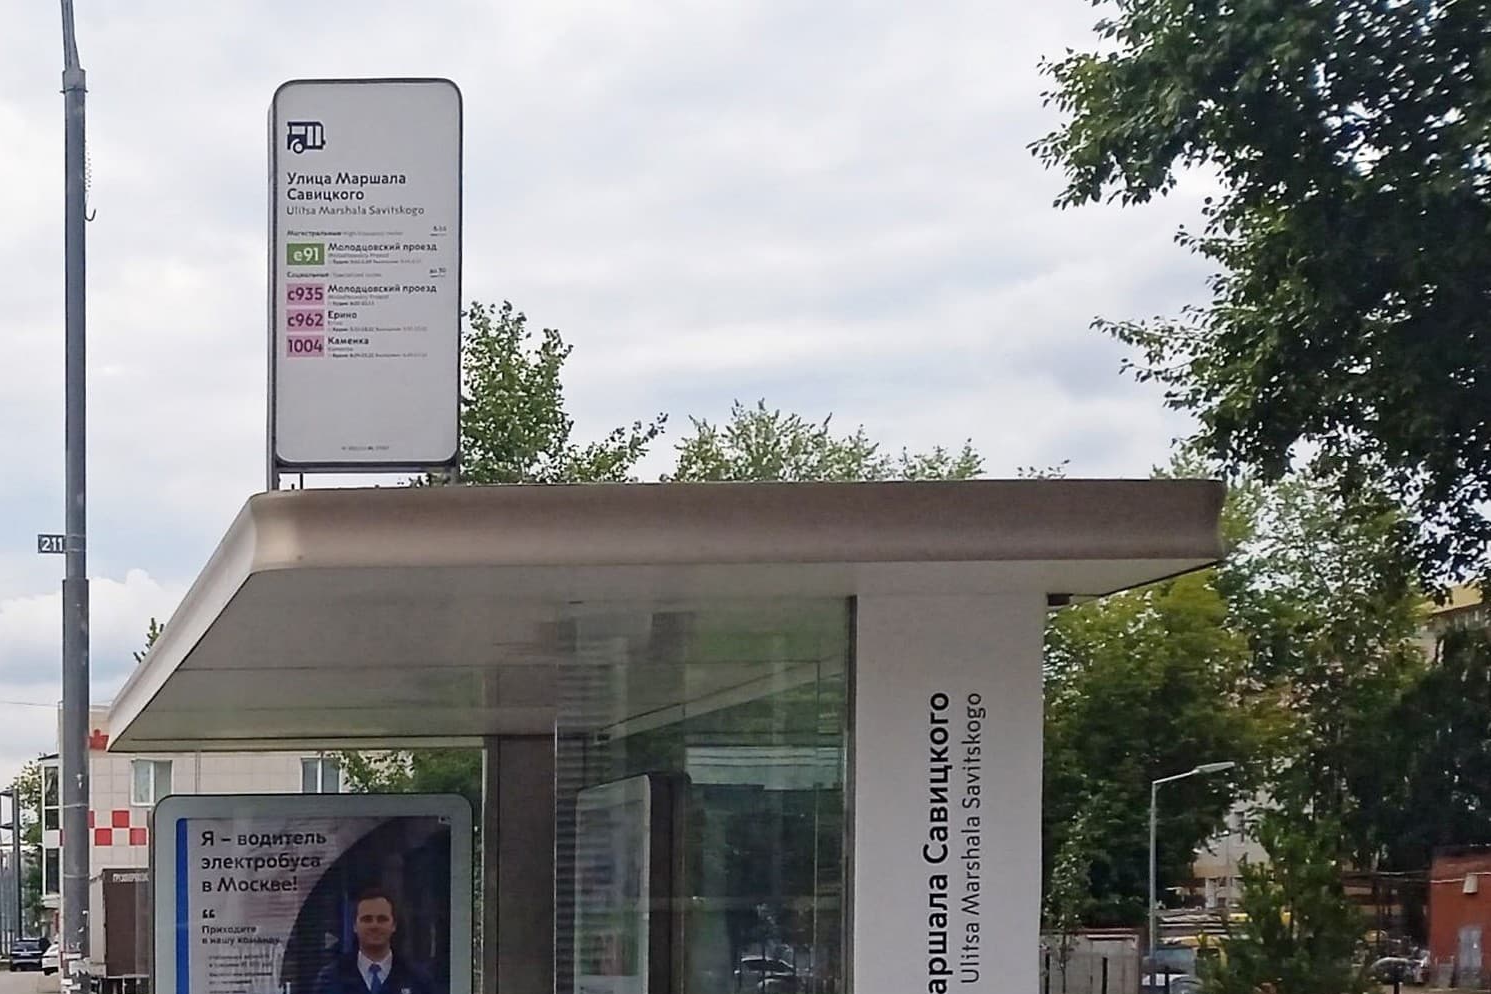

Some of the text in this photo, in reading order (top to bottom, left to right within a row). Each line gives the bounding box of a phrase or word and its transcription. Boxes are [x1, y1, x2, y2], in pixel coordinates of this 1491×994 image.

[287, 172, 406, 187] Улица Маршала
[287, 188, 364, 202] Савицкого
[286, 205, 425, 217] Ulitsa Marshala Savitskogo
[328, 242, 438, 252] Молодцовский проезд
[293, 247, 320, 262] e91
[327, 284, 438, 294] Молодцовский проезд
[327, 310, 358, 320] Ерино
[287, 338, 324, 353] 1004
[327, 337, 370, 346] Каменка
[41, 537, 63, 551] 211
[922, 691, 953, 864] Савицкого
[201, 831, 214, 846] Я
[237, 833, 327, 847] водитель
[960, 692, 986, 984] Ulitsa Marshala Savitskogo
[201, 853, 322, 872] электробуса
[202, 875, 298, 892] в Москве!
[202, 925, 257, 935] Приходите
[210, 936, 235, 946] нашу
